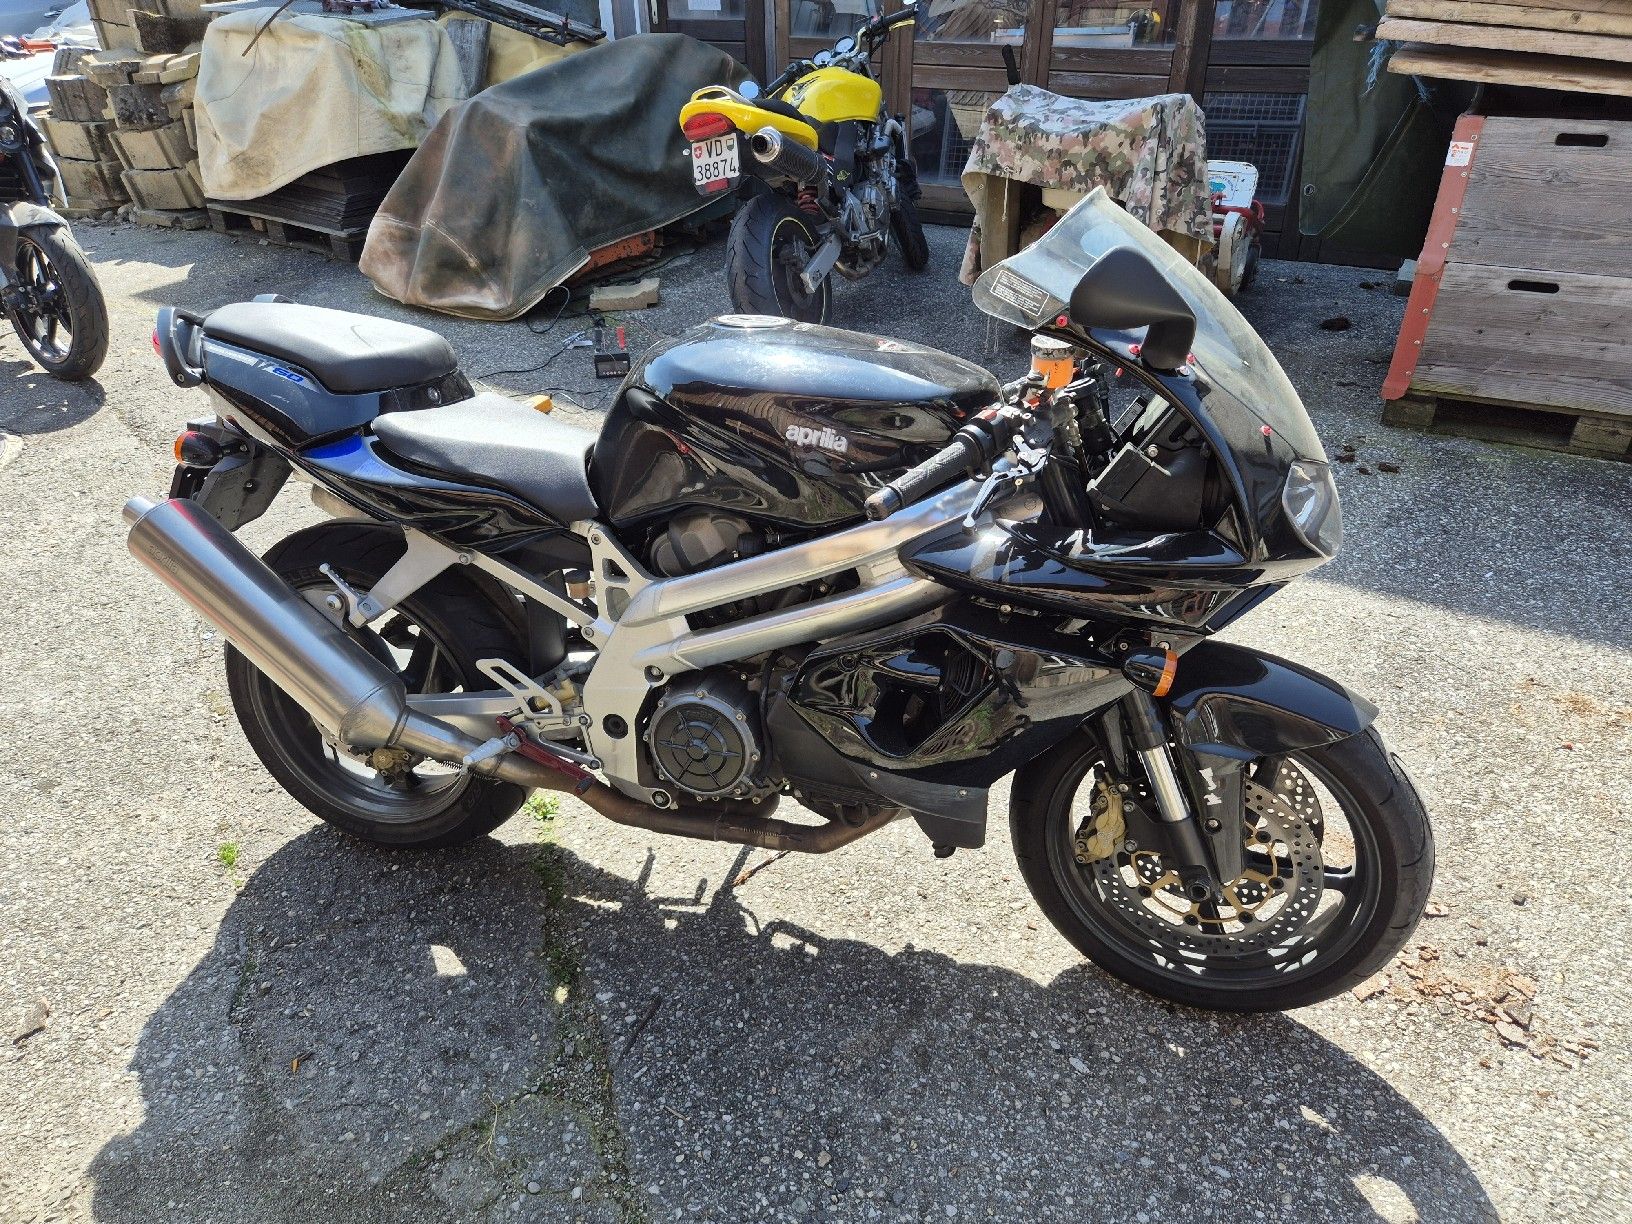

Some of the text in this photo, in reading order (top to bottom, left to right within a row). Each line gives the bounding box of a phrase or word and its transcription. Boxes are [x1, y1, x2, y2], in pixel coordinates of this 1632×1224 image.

[705, 140, 723, 158] VD
[696, 157, 737, 182] 38874
[785, 424, 848, 453] aprilia
